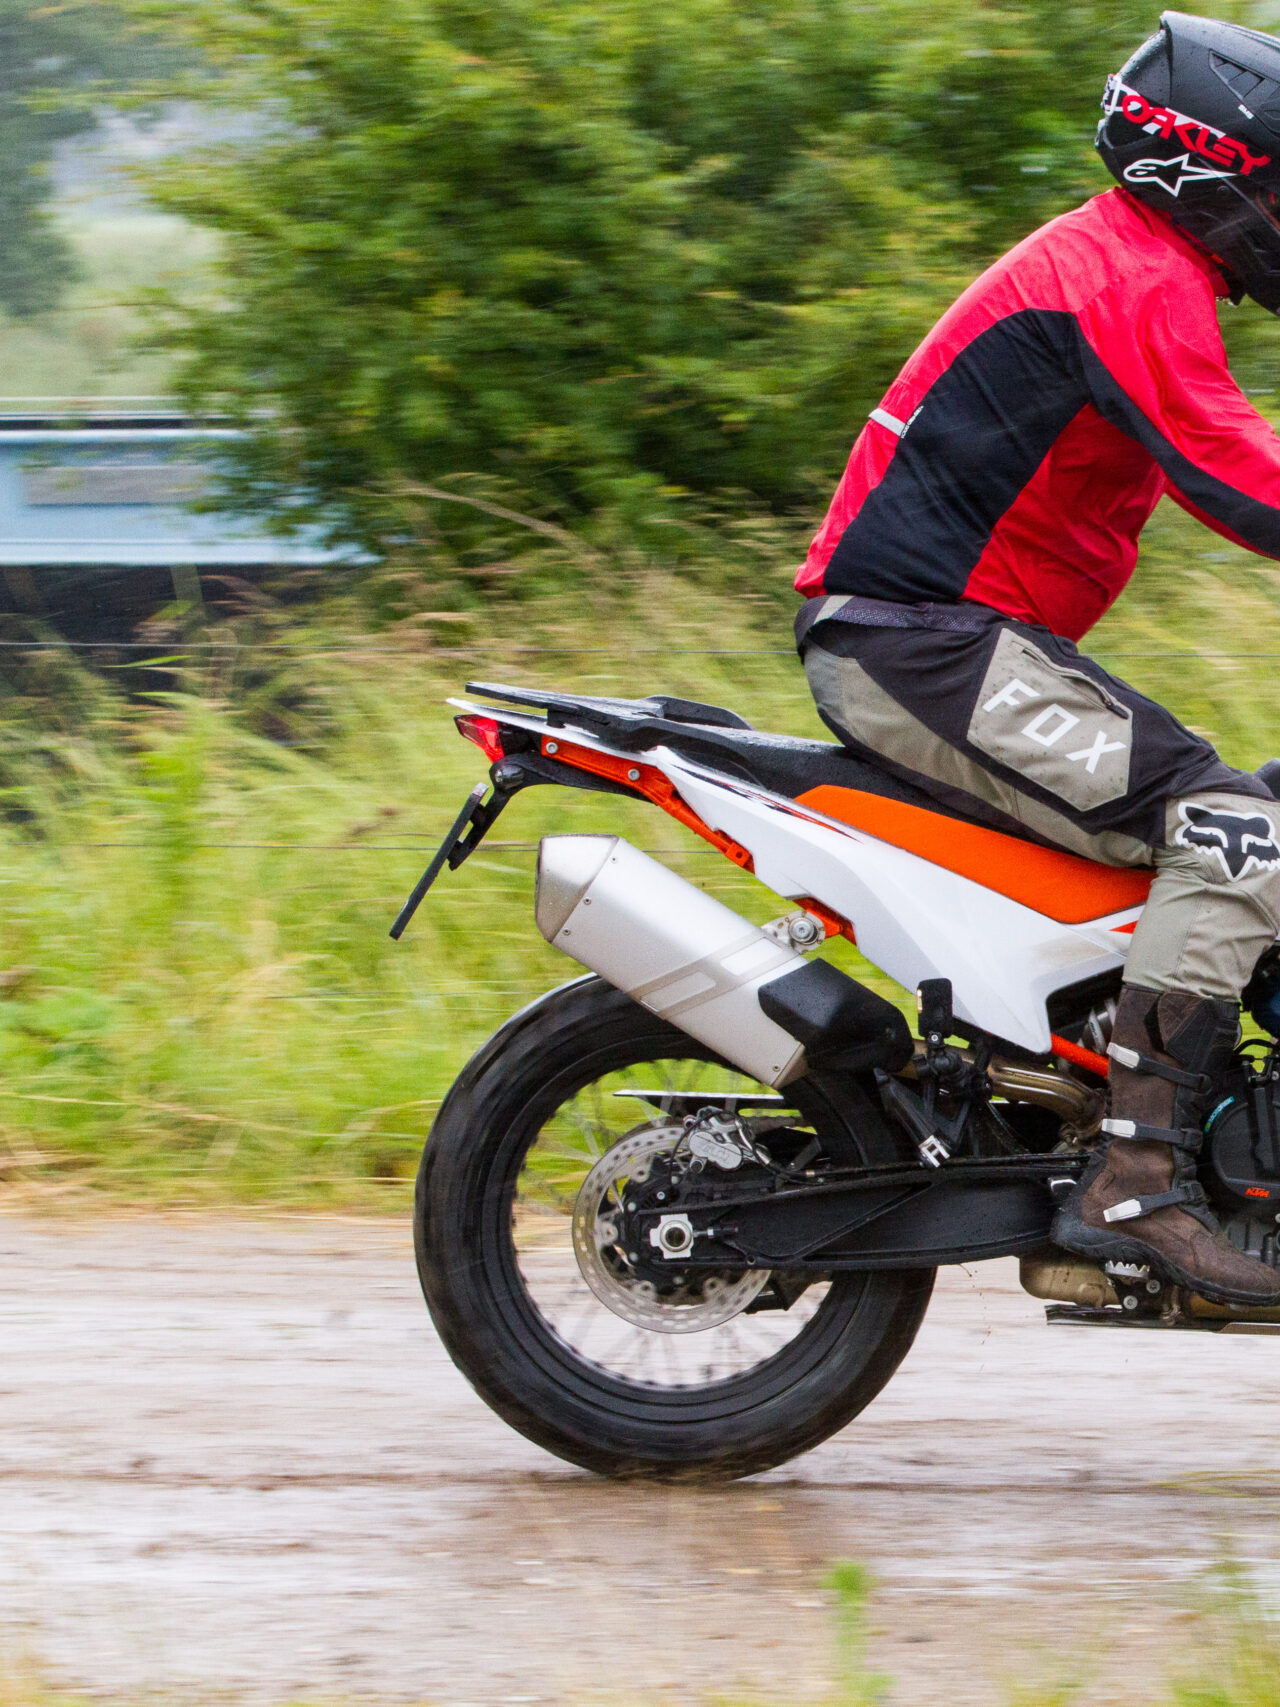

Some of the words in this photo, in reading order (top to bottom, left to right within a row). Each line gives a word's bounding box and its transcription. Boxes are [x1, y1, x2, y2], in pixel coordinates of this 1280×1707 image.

[1122, 94, 1272, 176] OAKLEY
[982, 678, 1127, 774] FOX
[1245, 1187, 1270, 1198] KTM
